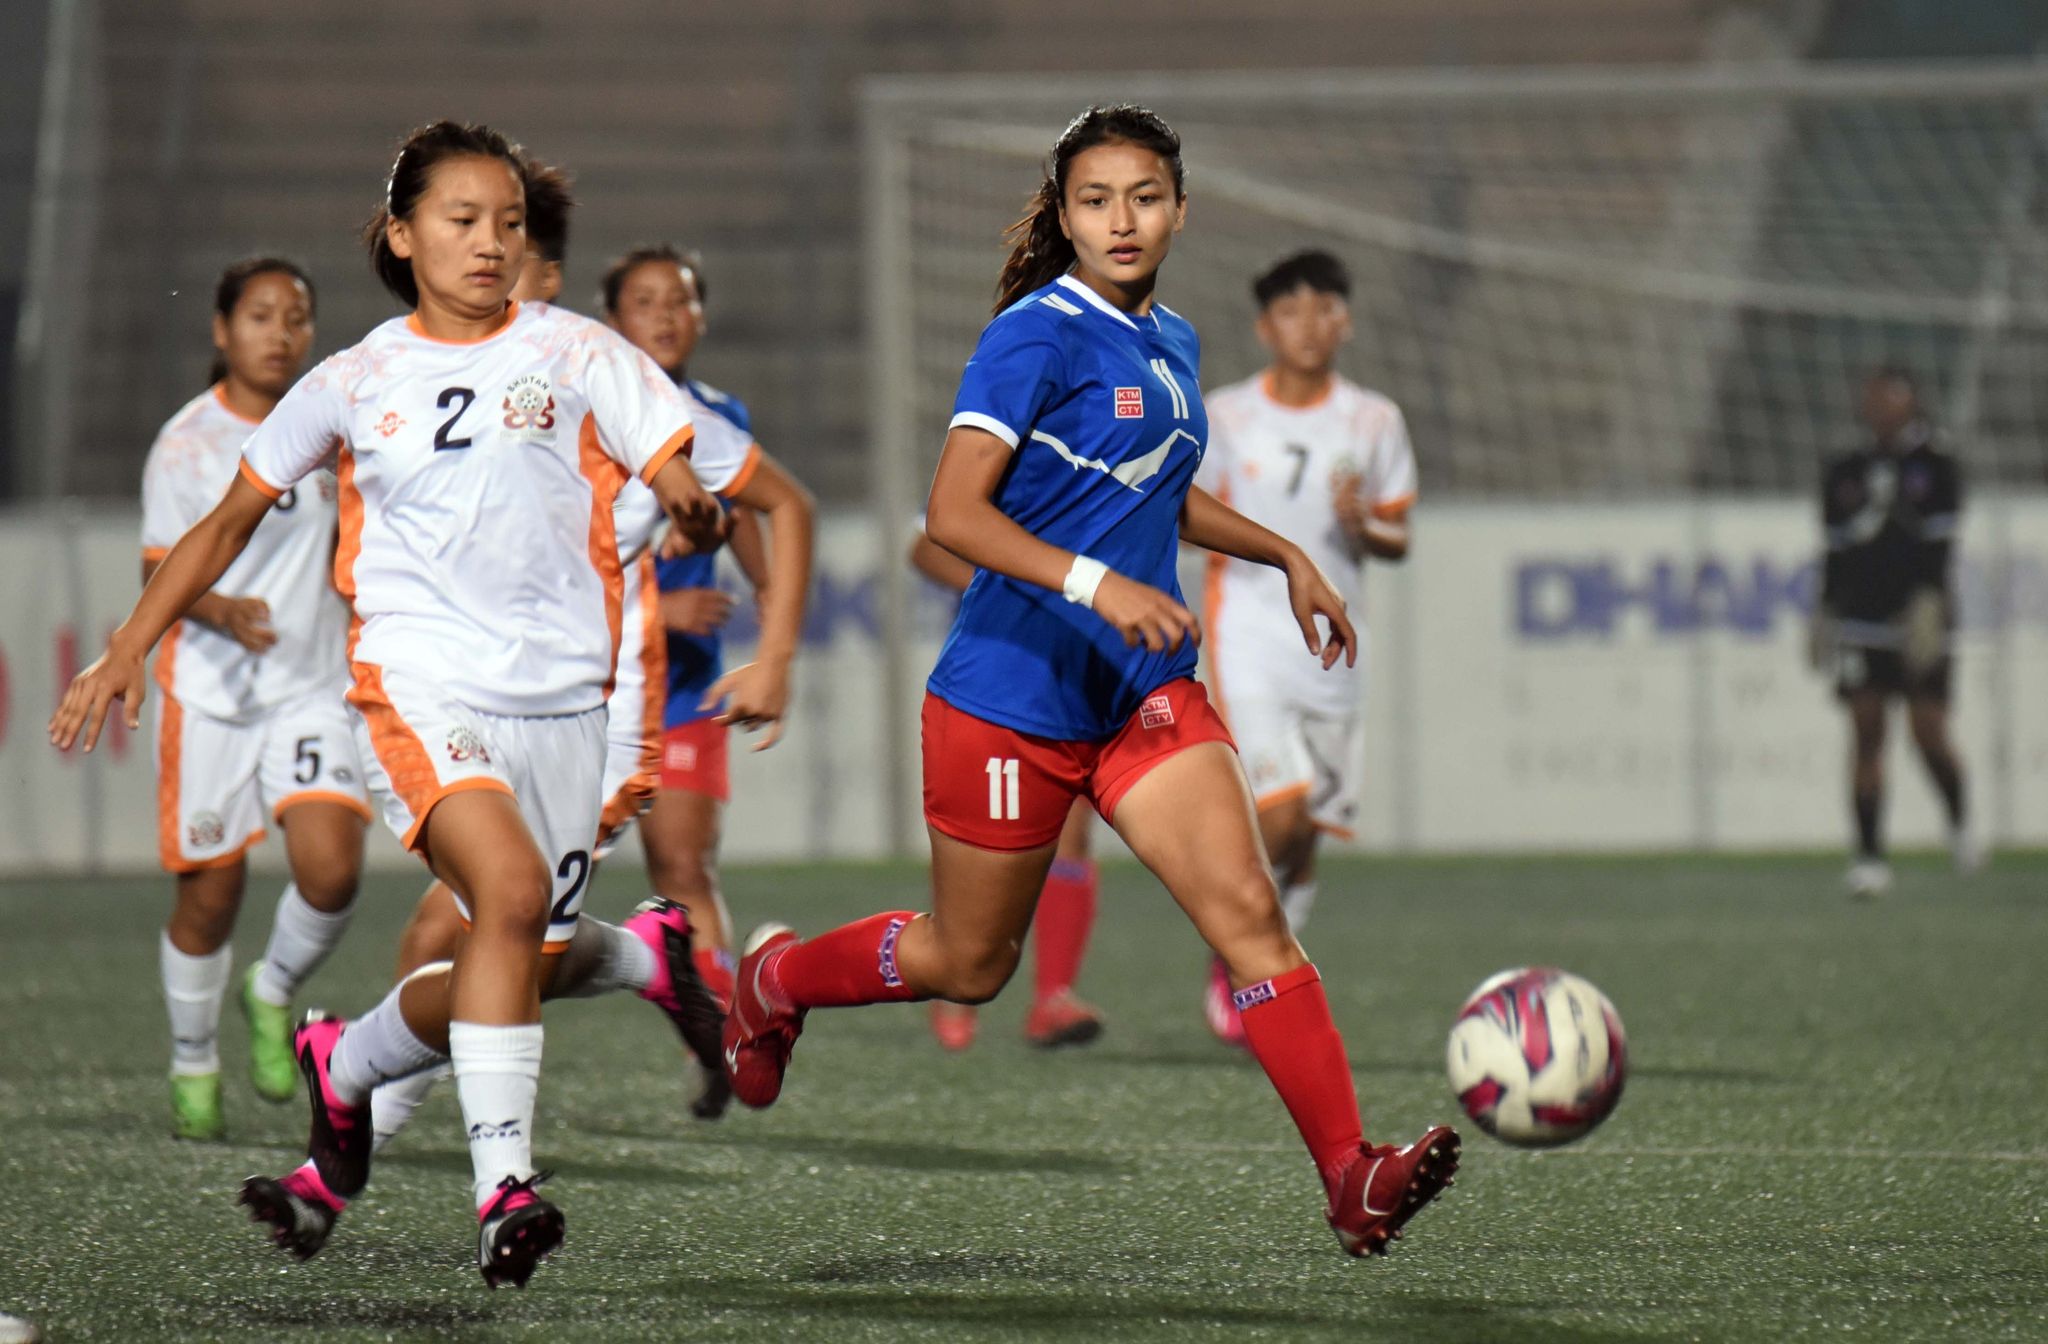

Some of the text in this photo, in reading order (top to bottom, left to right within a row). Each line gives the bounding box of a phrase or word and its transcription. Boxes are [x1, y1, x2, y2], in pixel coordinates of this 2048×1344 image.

[506, 375, 549, 392] BHUTAN
[1117, 391, 1140, 400] KTM
[1150, 358, 1190, 419] 11
[434, 386, 476, 453] 2
[1118, 405, 1141, 415] CTY
[1284, 442, 1310, 499] 7
[1142, 700, 1168, 711] KTM
[1145, 712, 1169, 724] CTY
[294, 735, 321, 784] 5
[984, 757, 1020, 820] 11
[550, 850, 589, 925] 2
